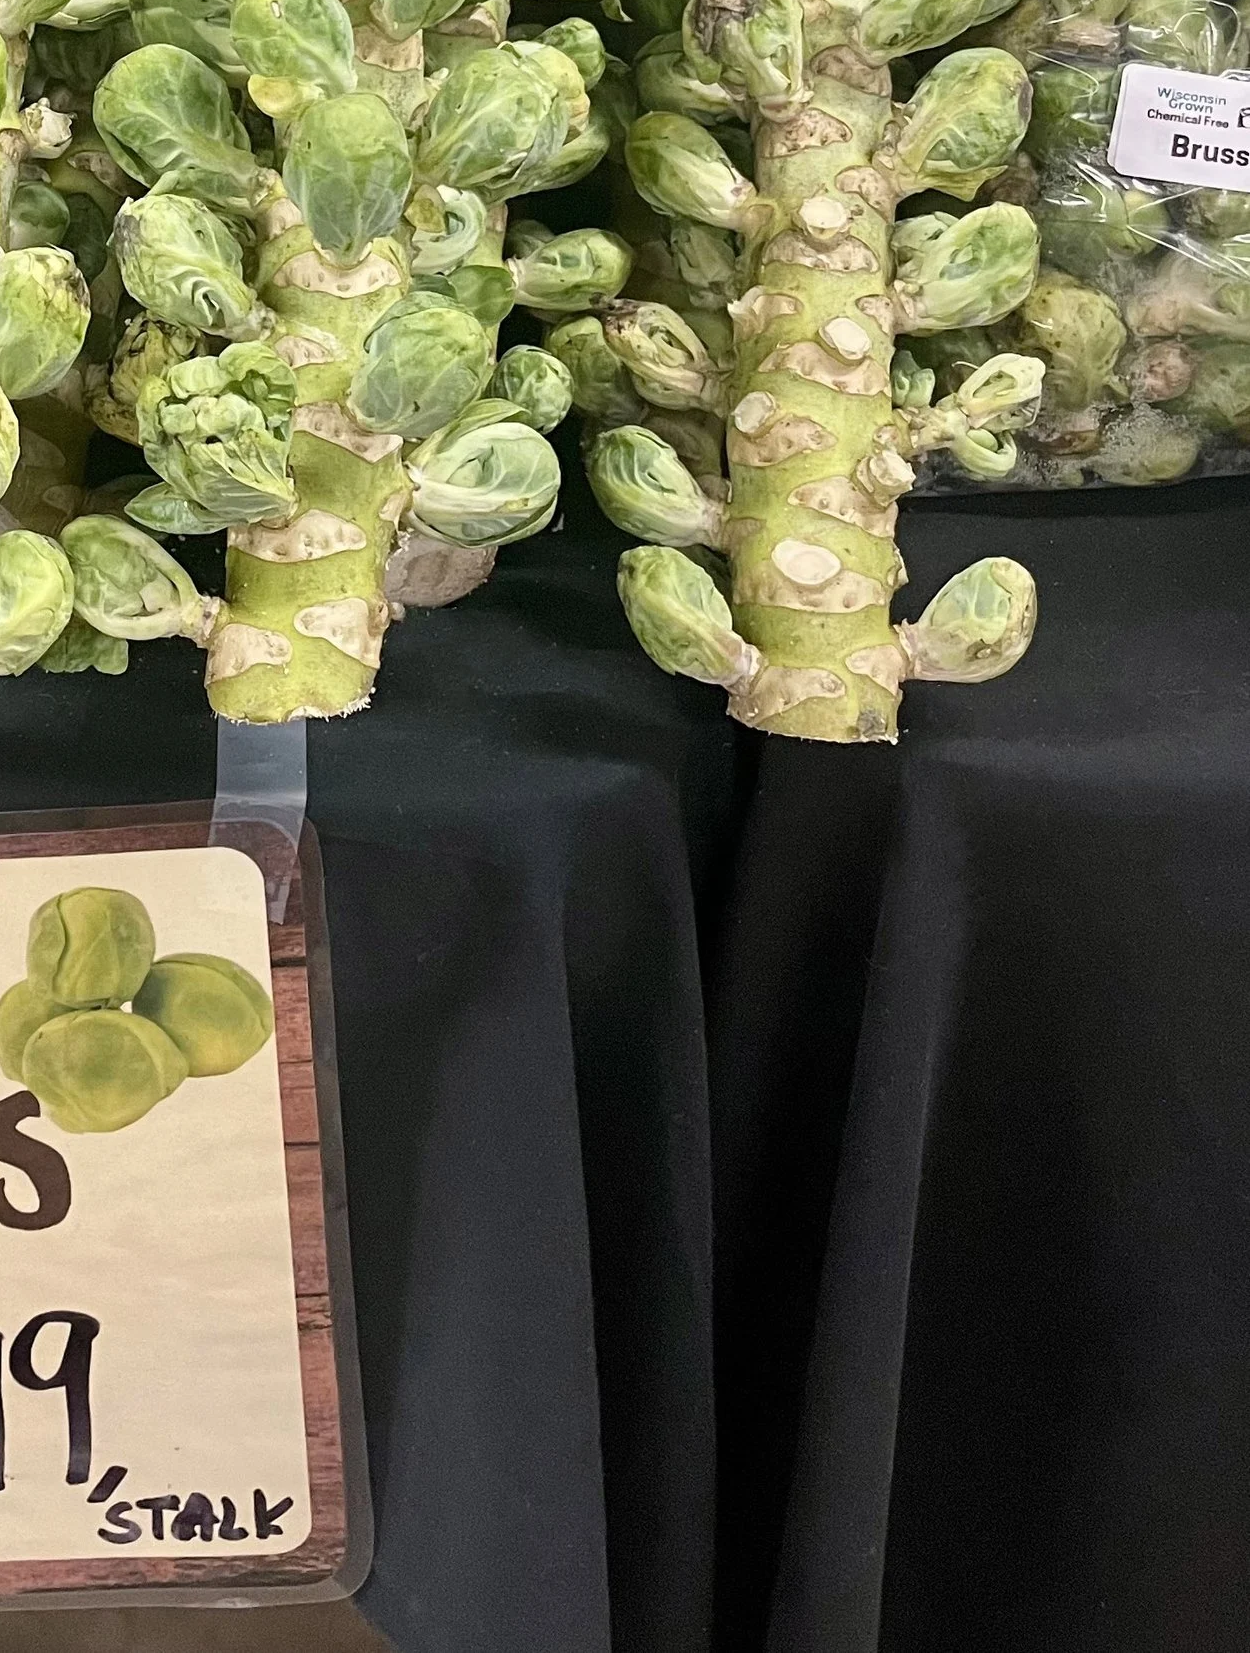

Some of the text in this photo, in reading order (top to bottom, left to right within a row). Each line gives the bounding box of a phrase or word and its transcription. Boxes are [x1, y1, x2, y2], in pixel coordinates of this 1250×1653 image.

[1157, 86, 1227, 106] Wisconsin
[1168, 98, 1213, 114] Grown
[1147, 108, 1229, 129] Chemical Free
[1171, 133, 1250, 167] Bruss
